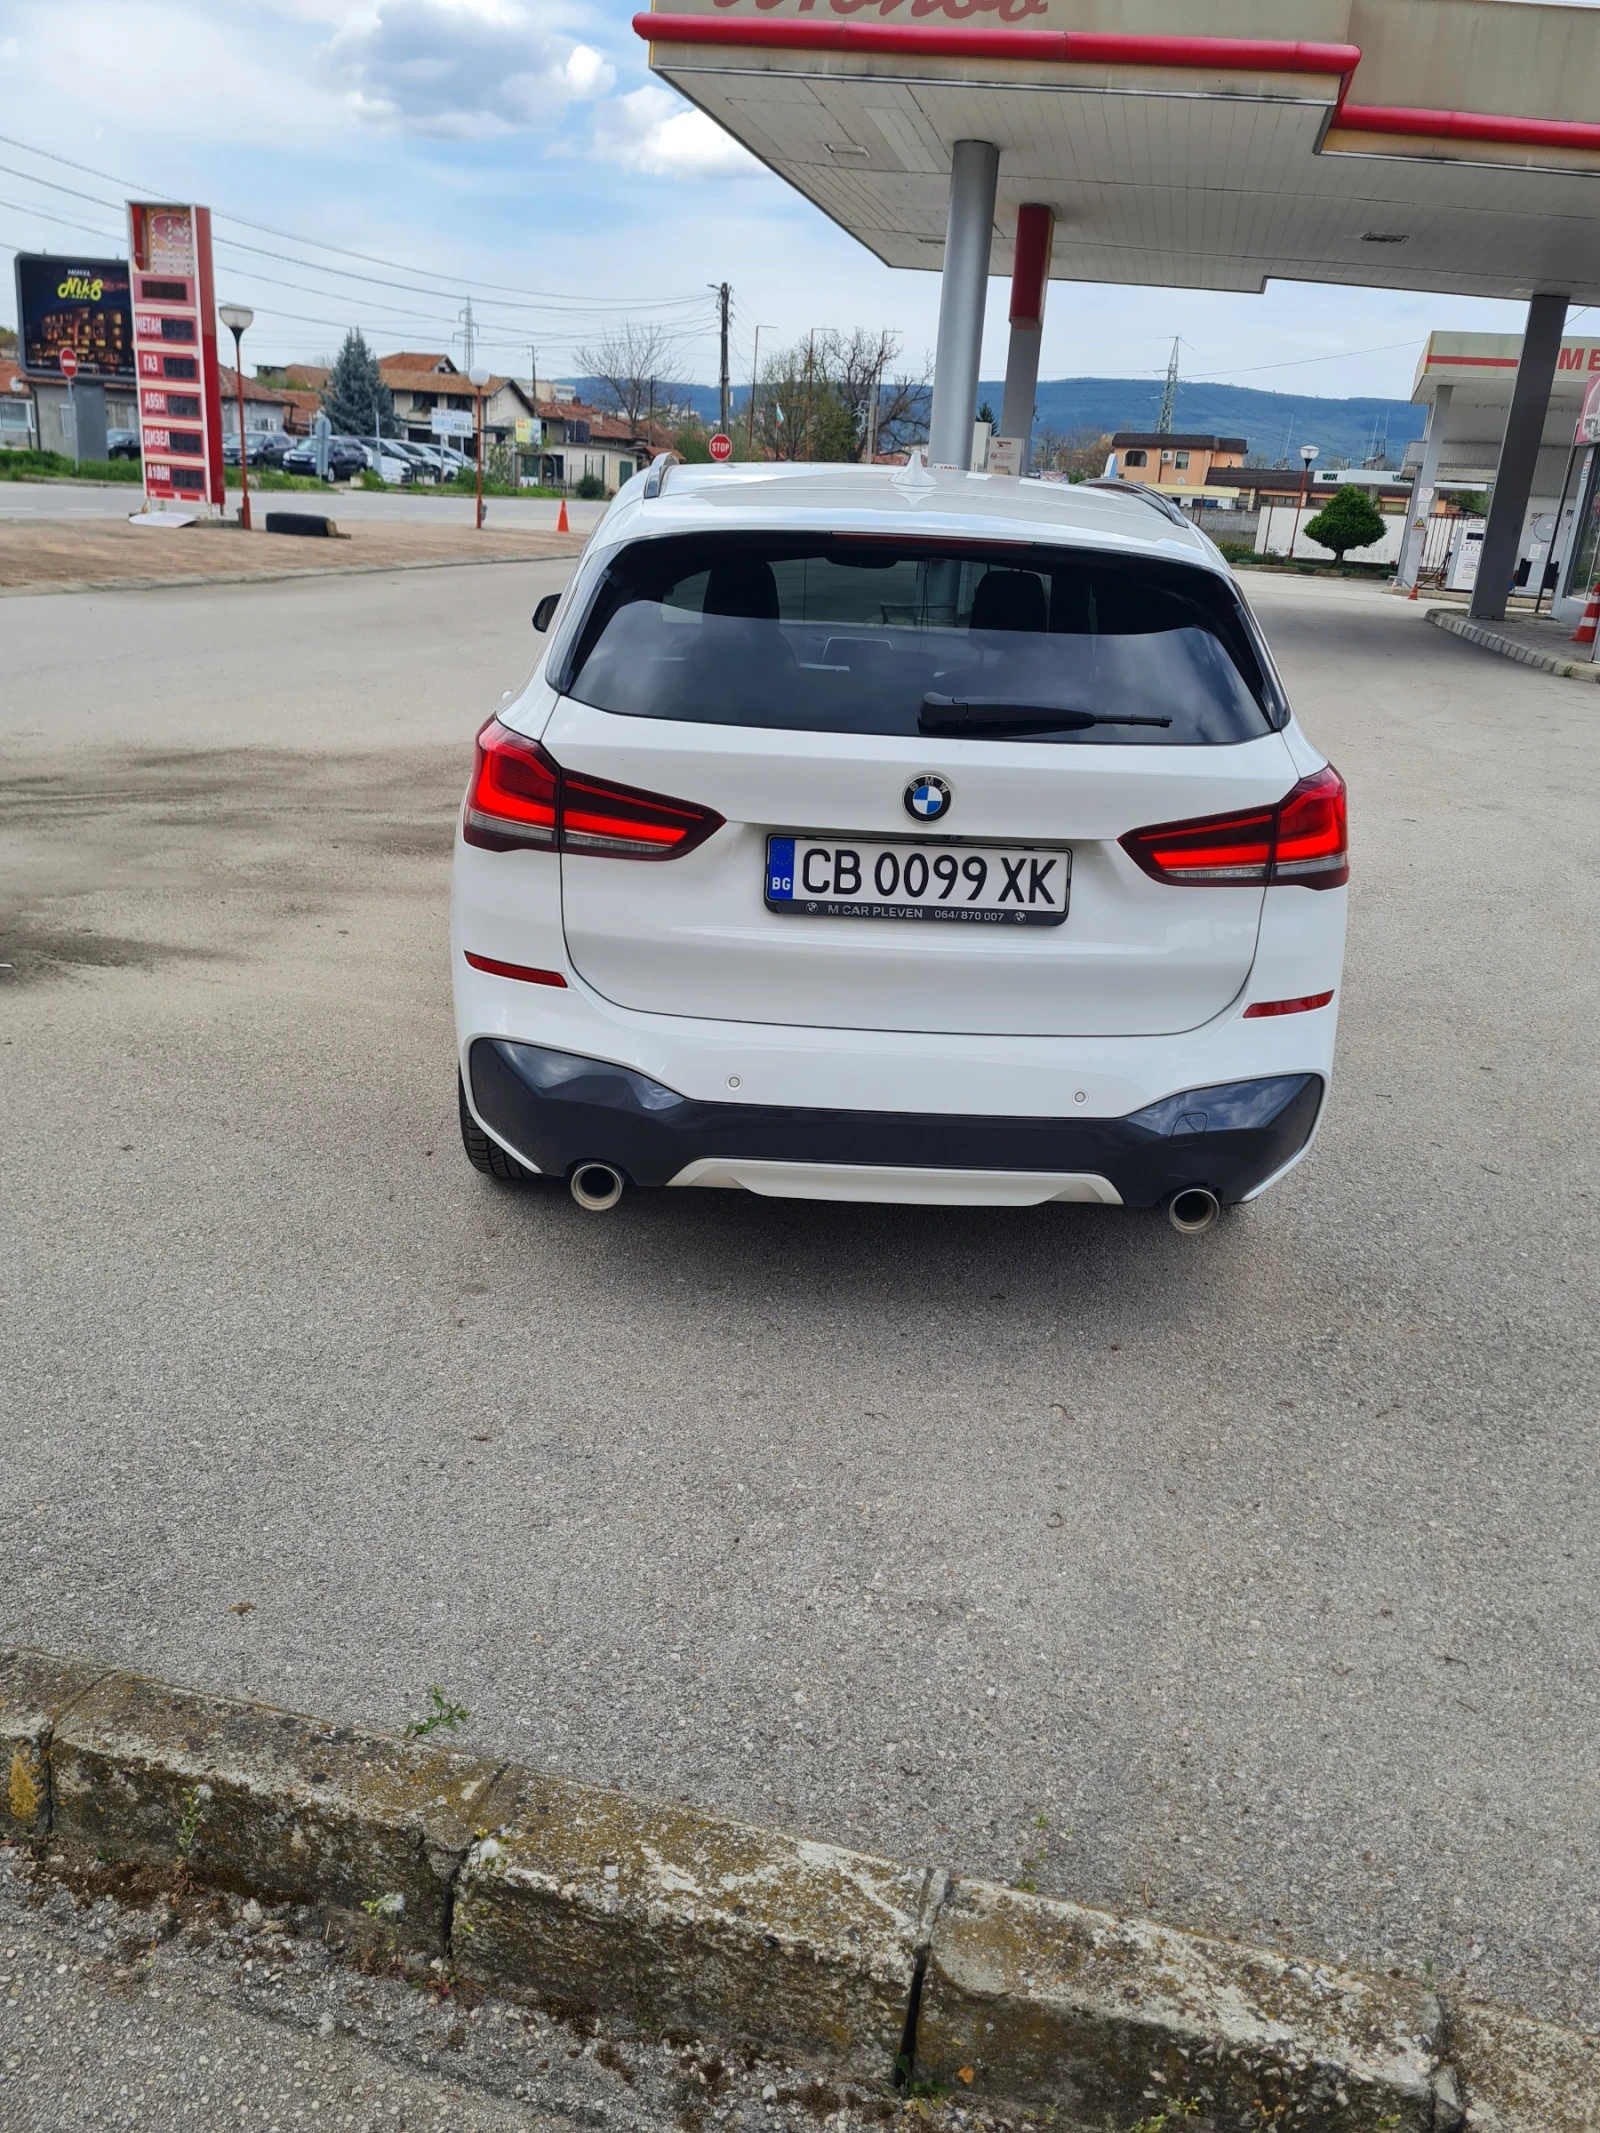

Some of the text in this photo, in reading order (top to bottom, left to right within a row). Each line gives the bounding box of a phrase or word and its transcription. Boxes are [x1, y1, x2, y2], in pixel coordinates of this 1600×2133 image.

[143, 354, 159, 372] ГАЗ
[144, 429, 170, 448] ДИЗЕЛ
[711, 442, 730, 453] STOP
[909, 776, 949, 793] BMW
[771, 876, 791, 891] BG
[802, 848, 1057, 904] CB 0099 XK
[827, 904, 839, 915] M
[842, 905, 869, 916] CAR
[872, 907, 923, 919] PLEVEN
[983, 912, 1005, 922] 007
